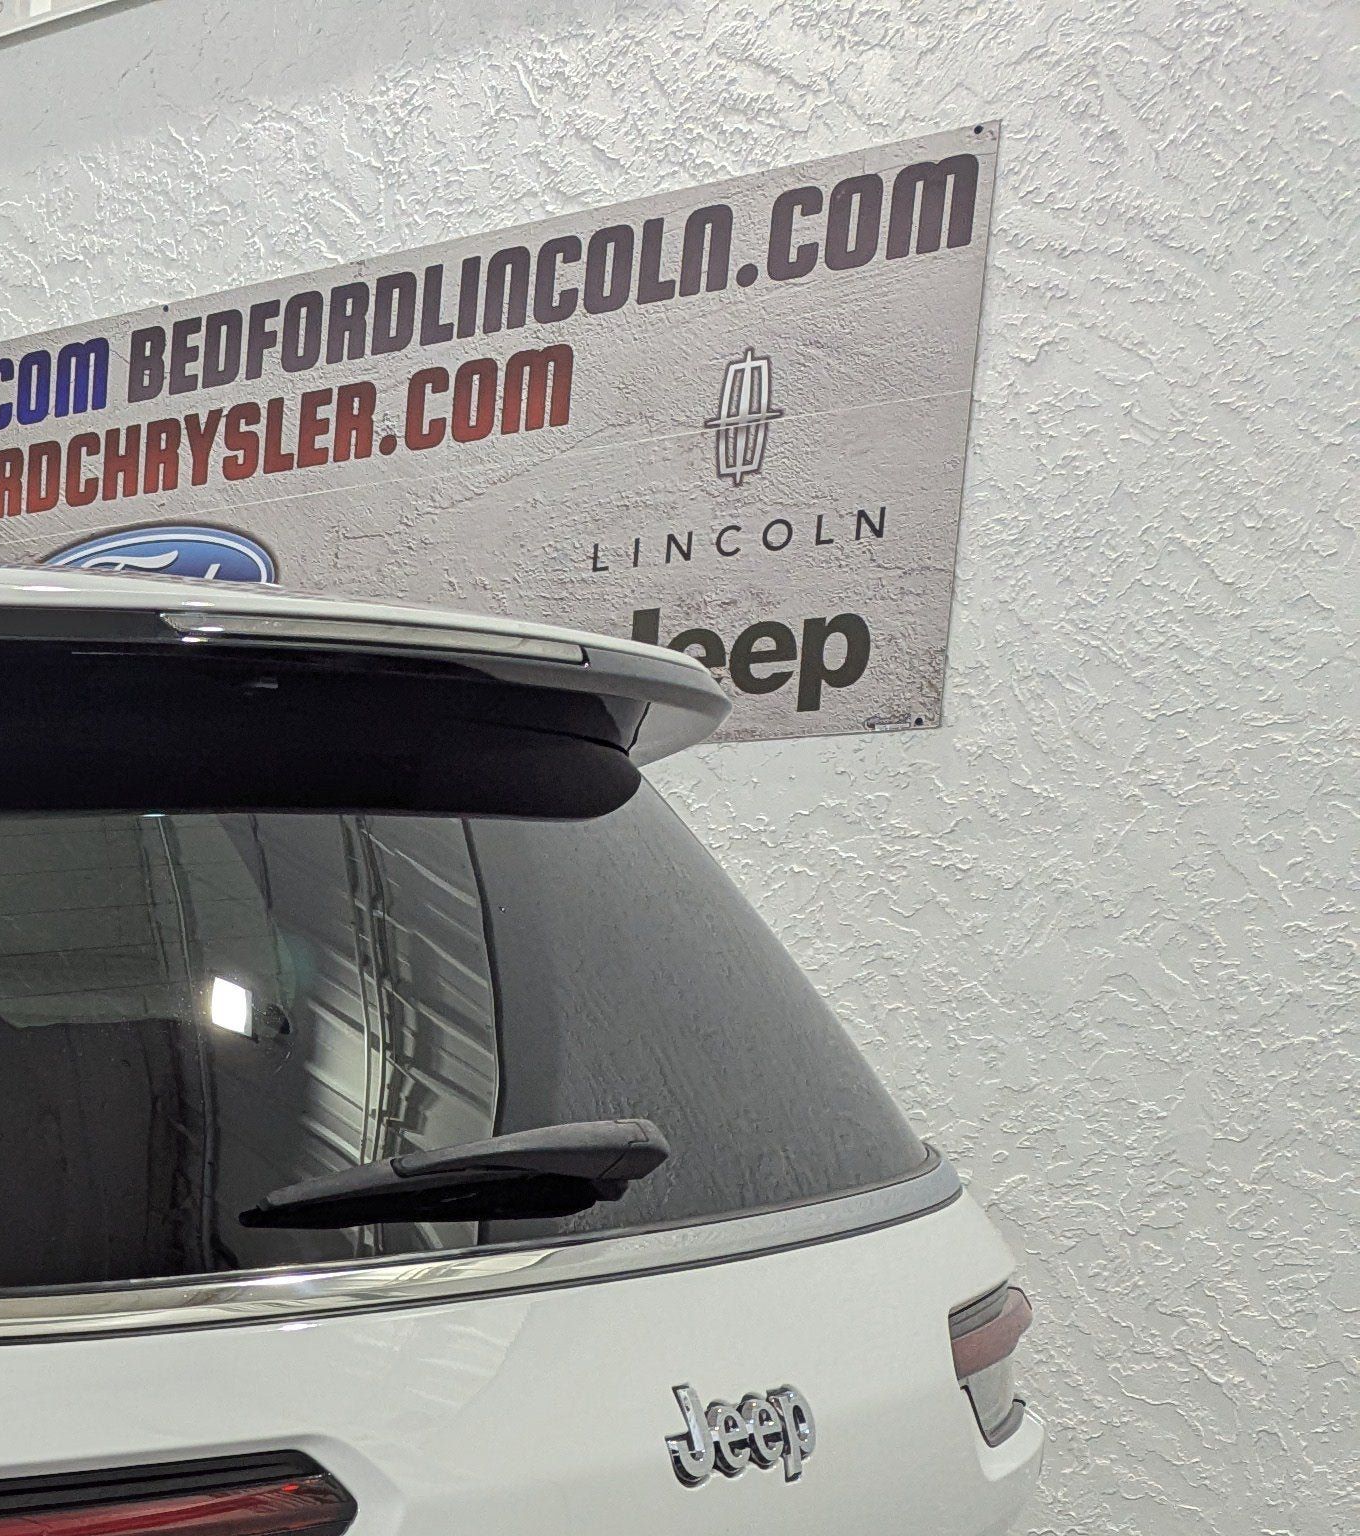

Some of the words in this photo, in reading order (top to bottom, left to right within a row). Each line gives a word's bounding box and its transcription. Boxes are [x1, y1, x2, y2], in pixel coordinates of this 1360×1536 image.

[127, 152, 981, 404] BEDFORDLINCOLN.COM
[590, 505, 888, 574] LINCOLN
[666, 1384, 817, 1488] Jeep
